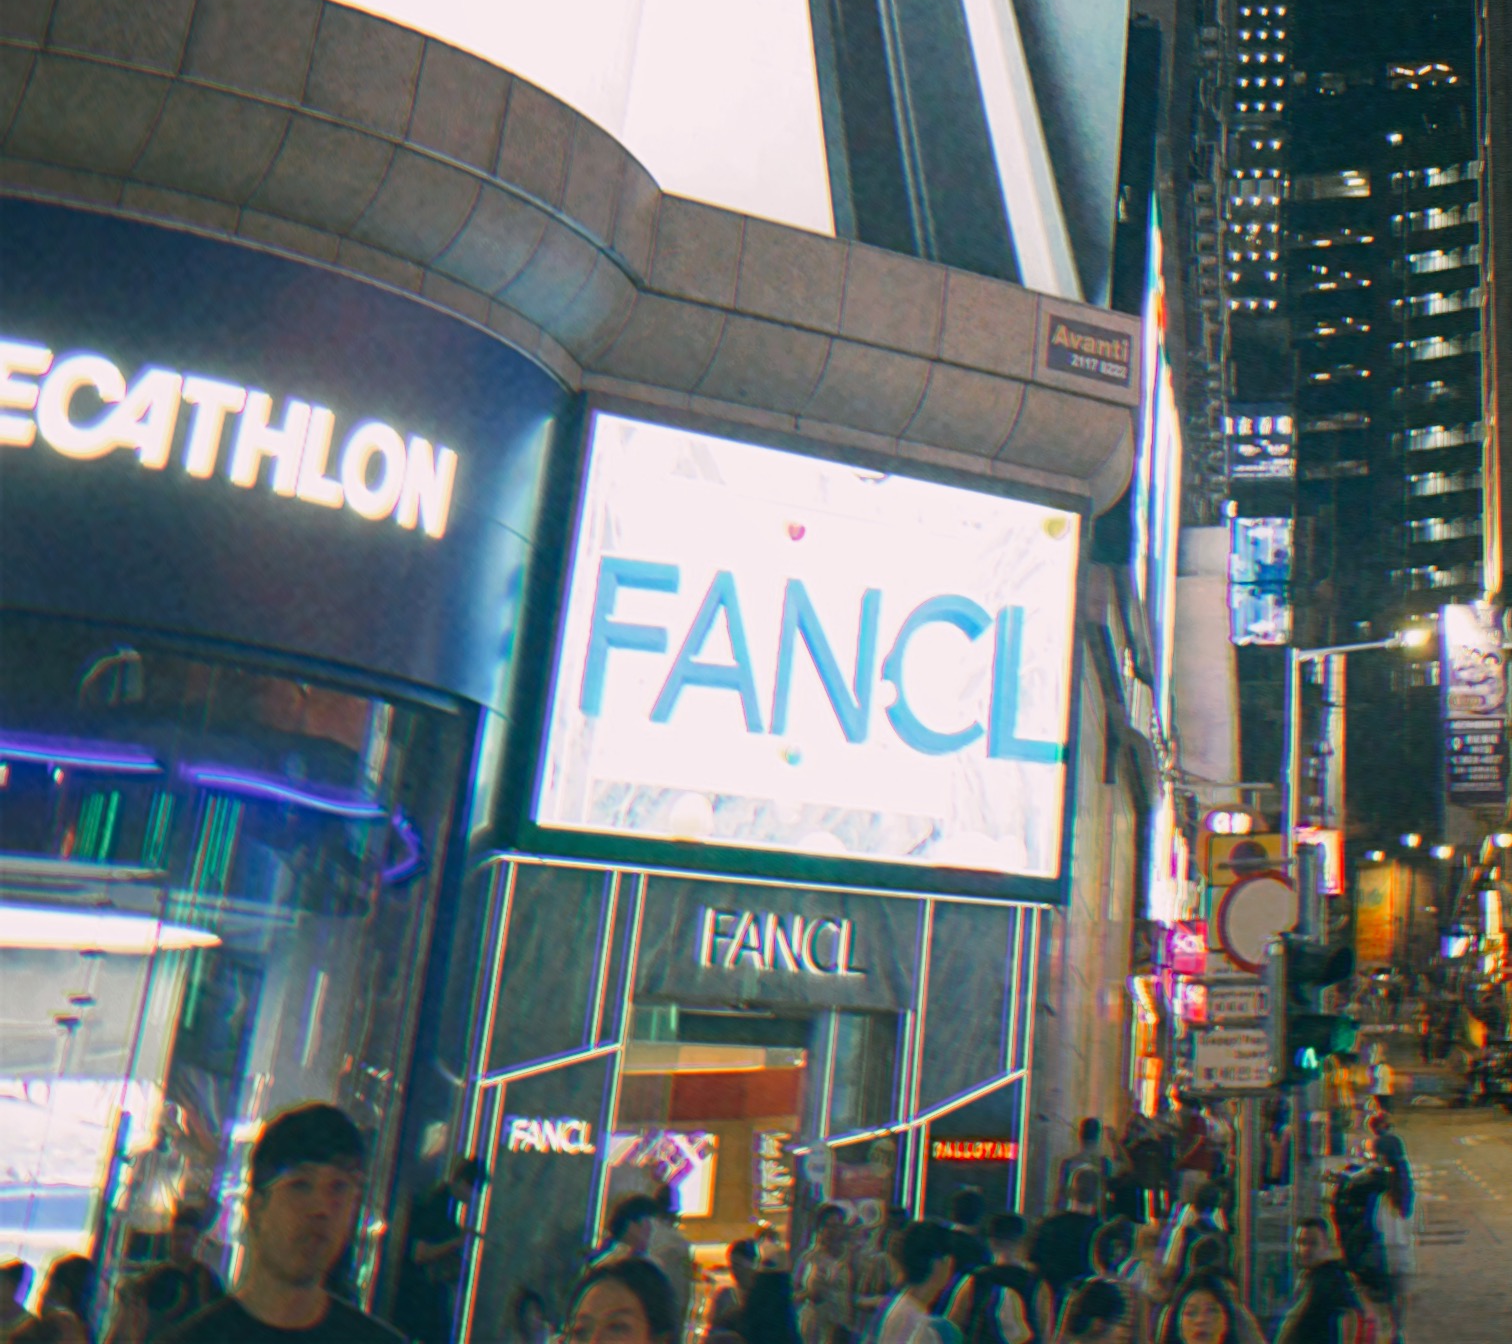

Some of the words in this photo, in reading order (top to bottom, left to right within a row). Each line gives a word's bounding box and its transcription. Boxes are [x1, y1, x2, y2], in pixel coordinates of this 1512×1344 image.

[1051, 324, 1129, 363] Avanti
[579, 556, 1068, 765] FANCL
[700, 906, 866, 978] FANCL
[507, 1118, 597, 1155] FANCL
